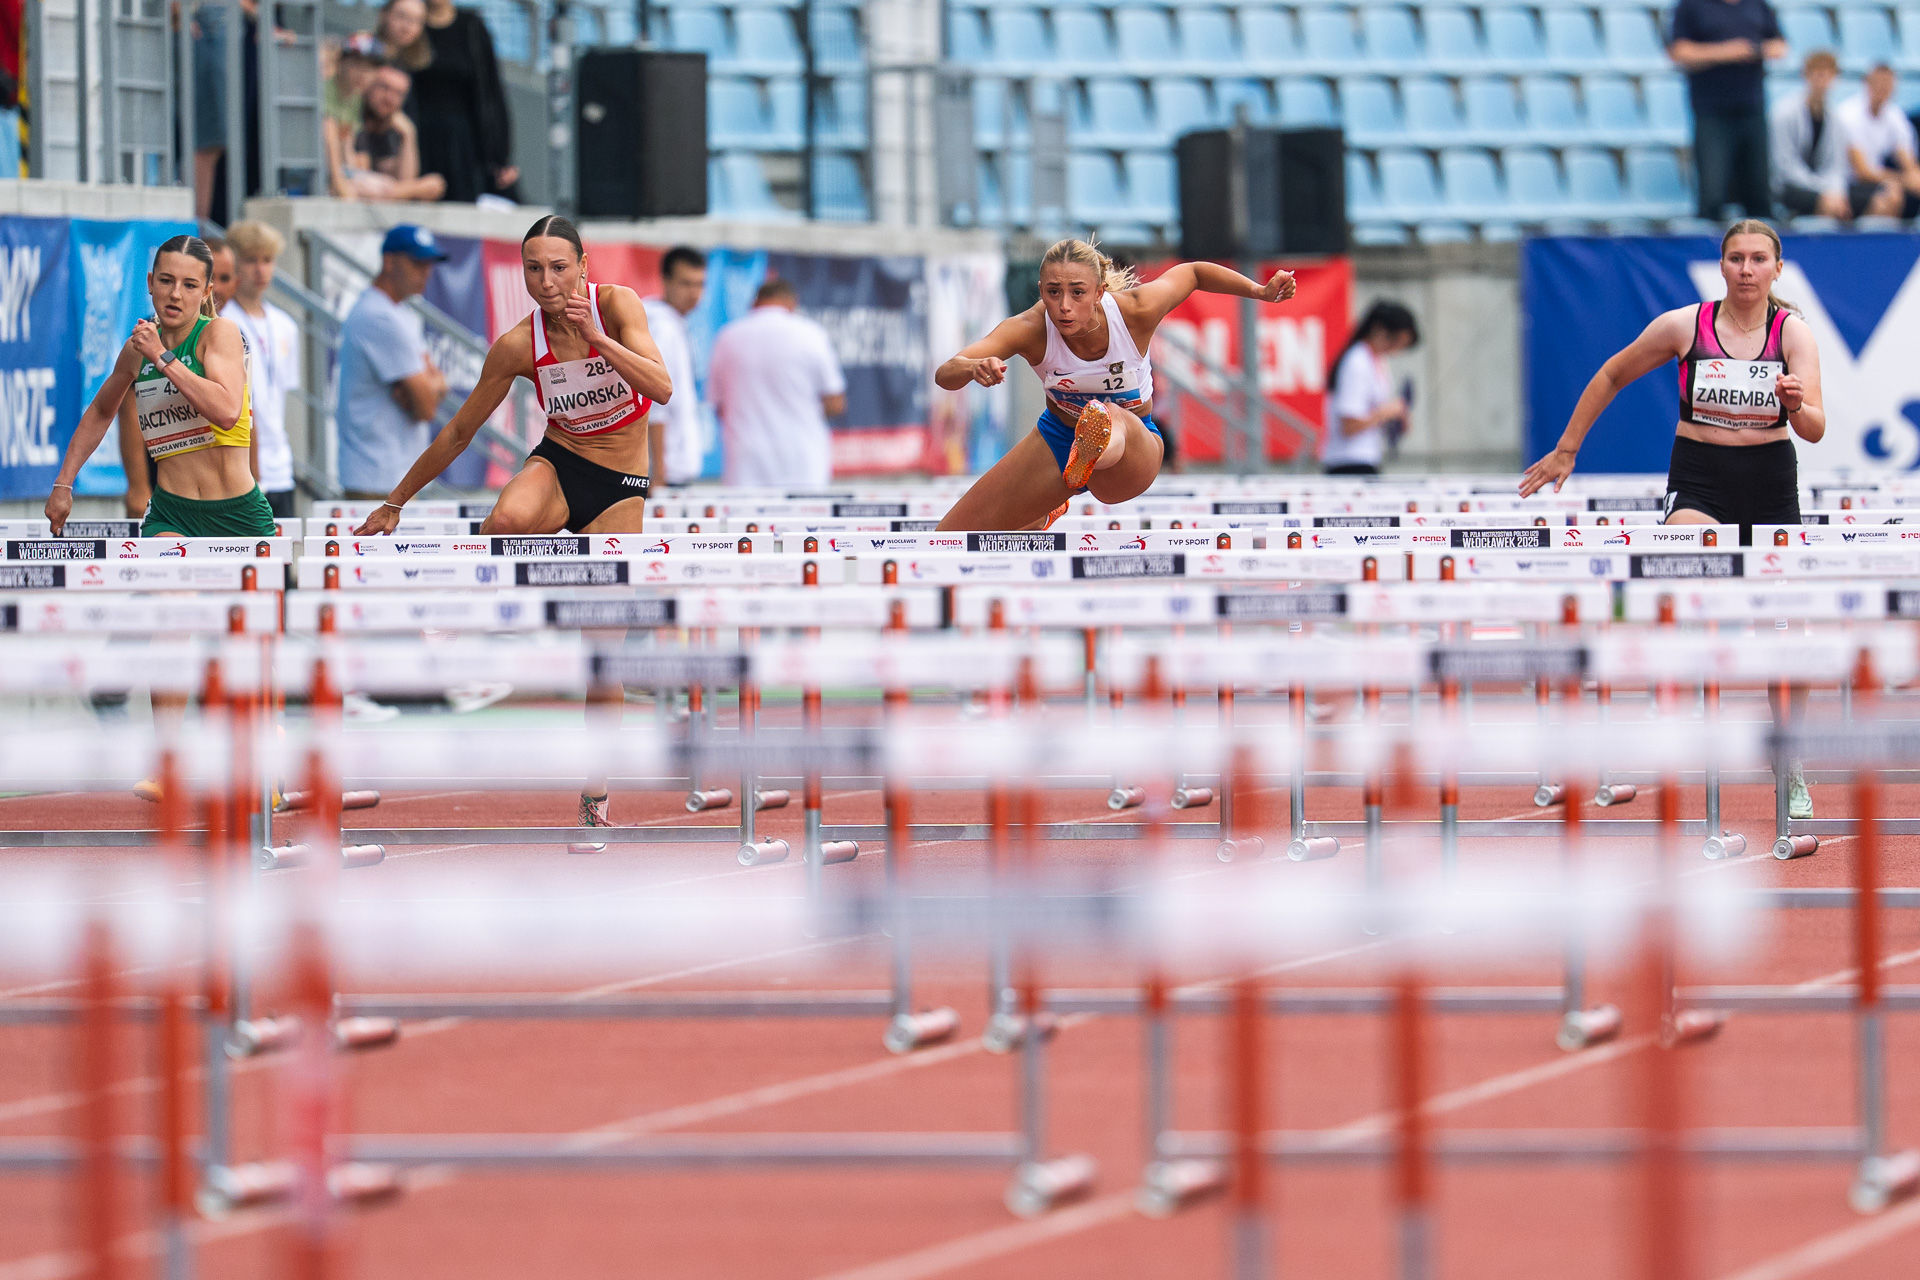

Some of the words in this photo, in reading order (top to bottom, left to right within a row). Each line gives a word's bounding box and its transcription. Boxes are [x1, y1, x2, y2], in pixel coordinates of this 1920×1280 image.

[584, 361, 614, 378] 285
[1749, 365, 1768, 379] 95
[1103, 377, 1124, 391] 12
[548, 382, 628, 415] JAWORSKA
[1696, 388, 1777, 408] ZAREMBA
[610, 409, 627, 423] 2025
[189, 436, 206, 446] 2025
[979, 540, 1031, 552] WŁOCŁAWEK
[1033, 540, 1054, 551] 2025
[1462, 537, 1515, 548] WŁOCŁAWEK
[1517, 536, 1539, 547] 2025
[19, 548, 71, 560] WŁOCŁAWEK
[73, 548, 95, 559] 2025
[503, 546, 555, 556] WŁOCŁAWEK
[557, 545, 578, 555] 2025
